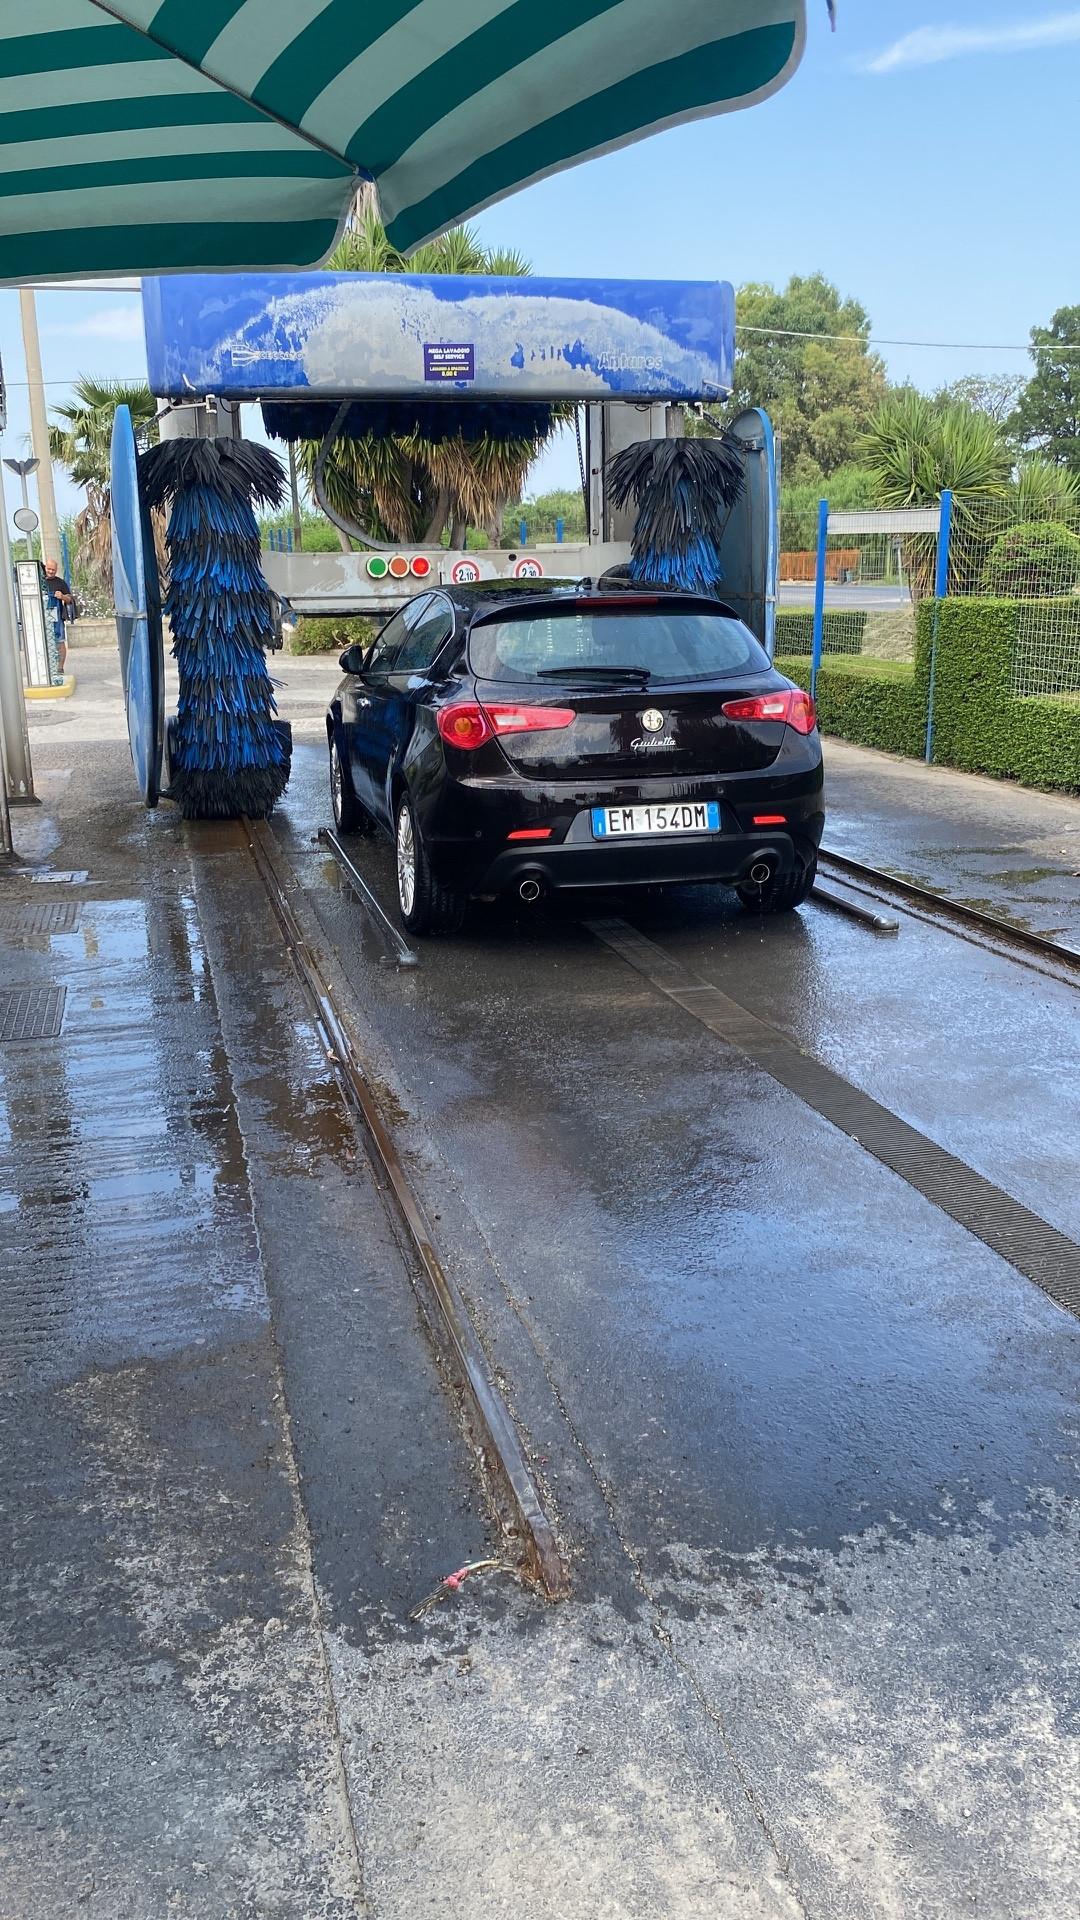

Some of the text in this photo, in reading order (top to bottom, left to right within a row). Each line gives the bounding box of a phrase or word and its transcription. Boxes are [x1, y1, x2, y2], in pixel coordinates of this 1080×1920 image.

[597, 352, 663, 370] Antares
[522, 567, 537, 578] 230
[630, 736, 676, 750] Giulietta
[608, 806, 706, 832] EM 154DM
